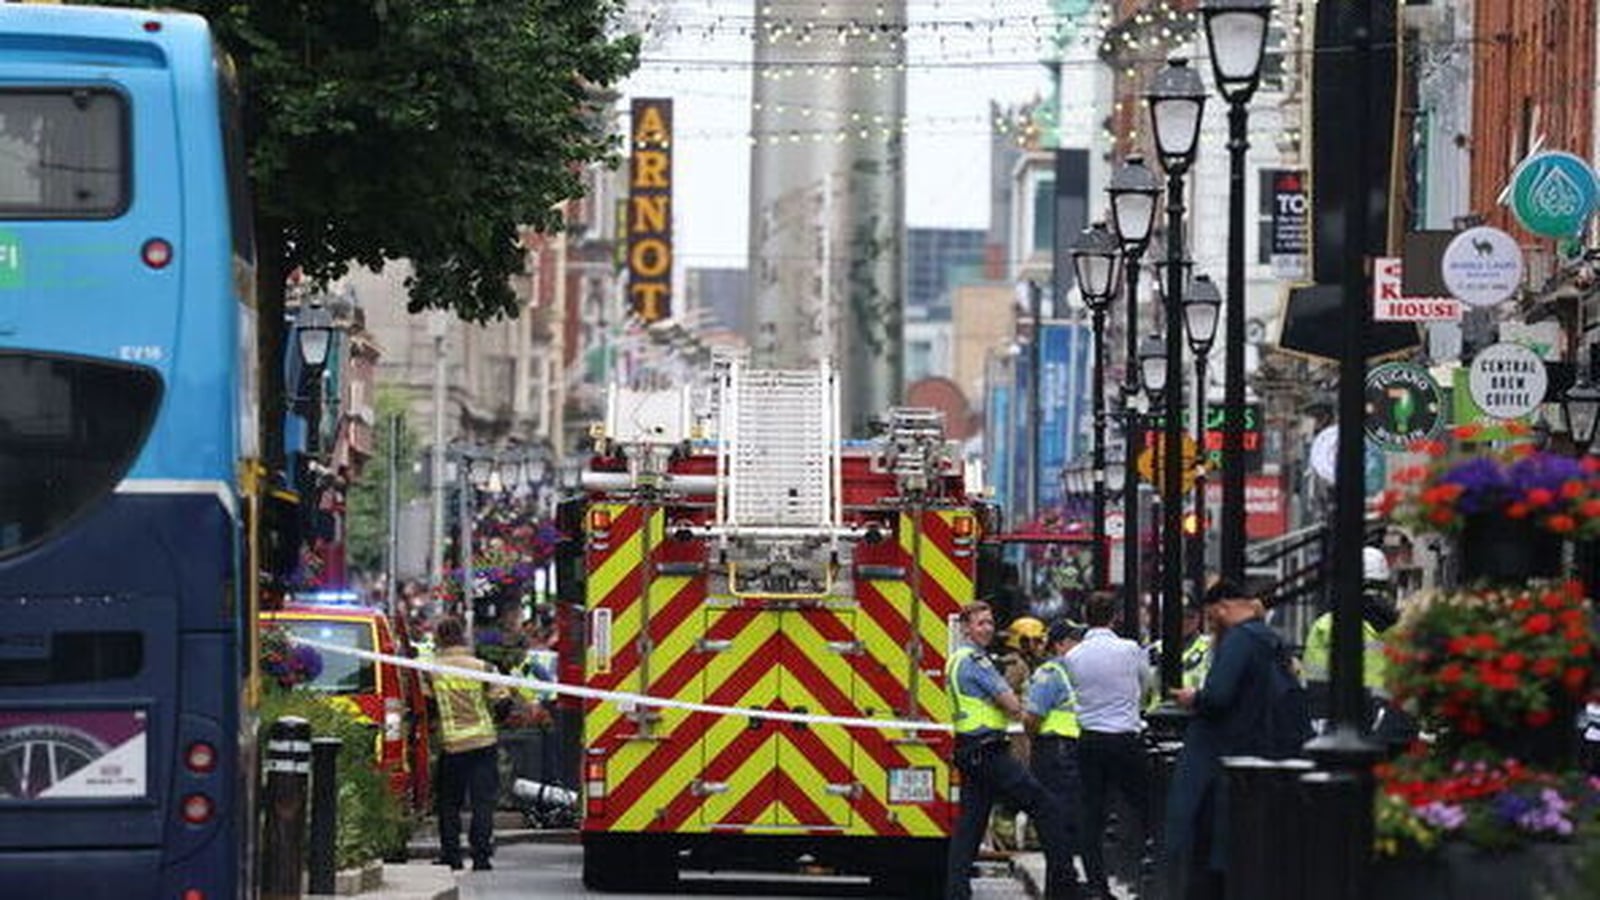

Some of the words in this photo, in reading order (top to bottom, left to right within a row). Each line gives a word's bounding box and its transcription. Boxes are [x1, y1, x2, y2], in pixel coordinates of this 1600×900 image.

[1389, 302, 1455, 316] HOUSE
[1481, 360, 1536, 374] CENTRAL
[1491, 376, 1525, 389] BREW
[1485, 392, 1530, 407] COFFEE
